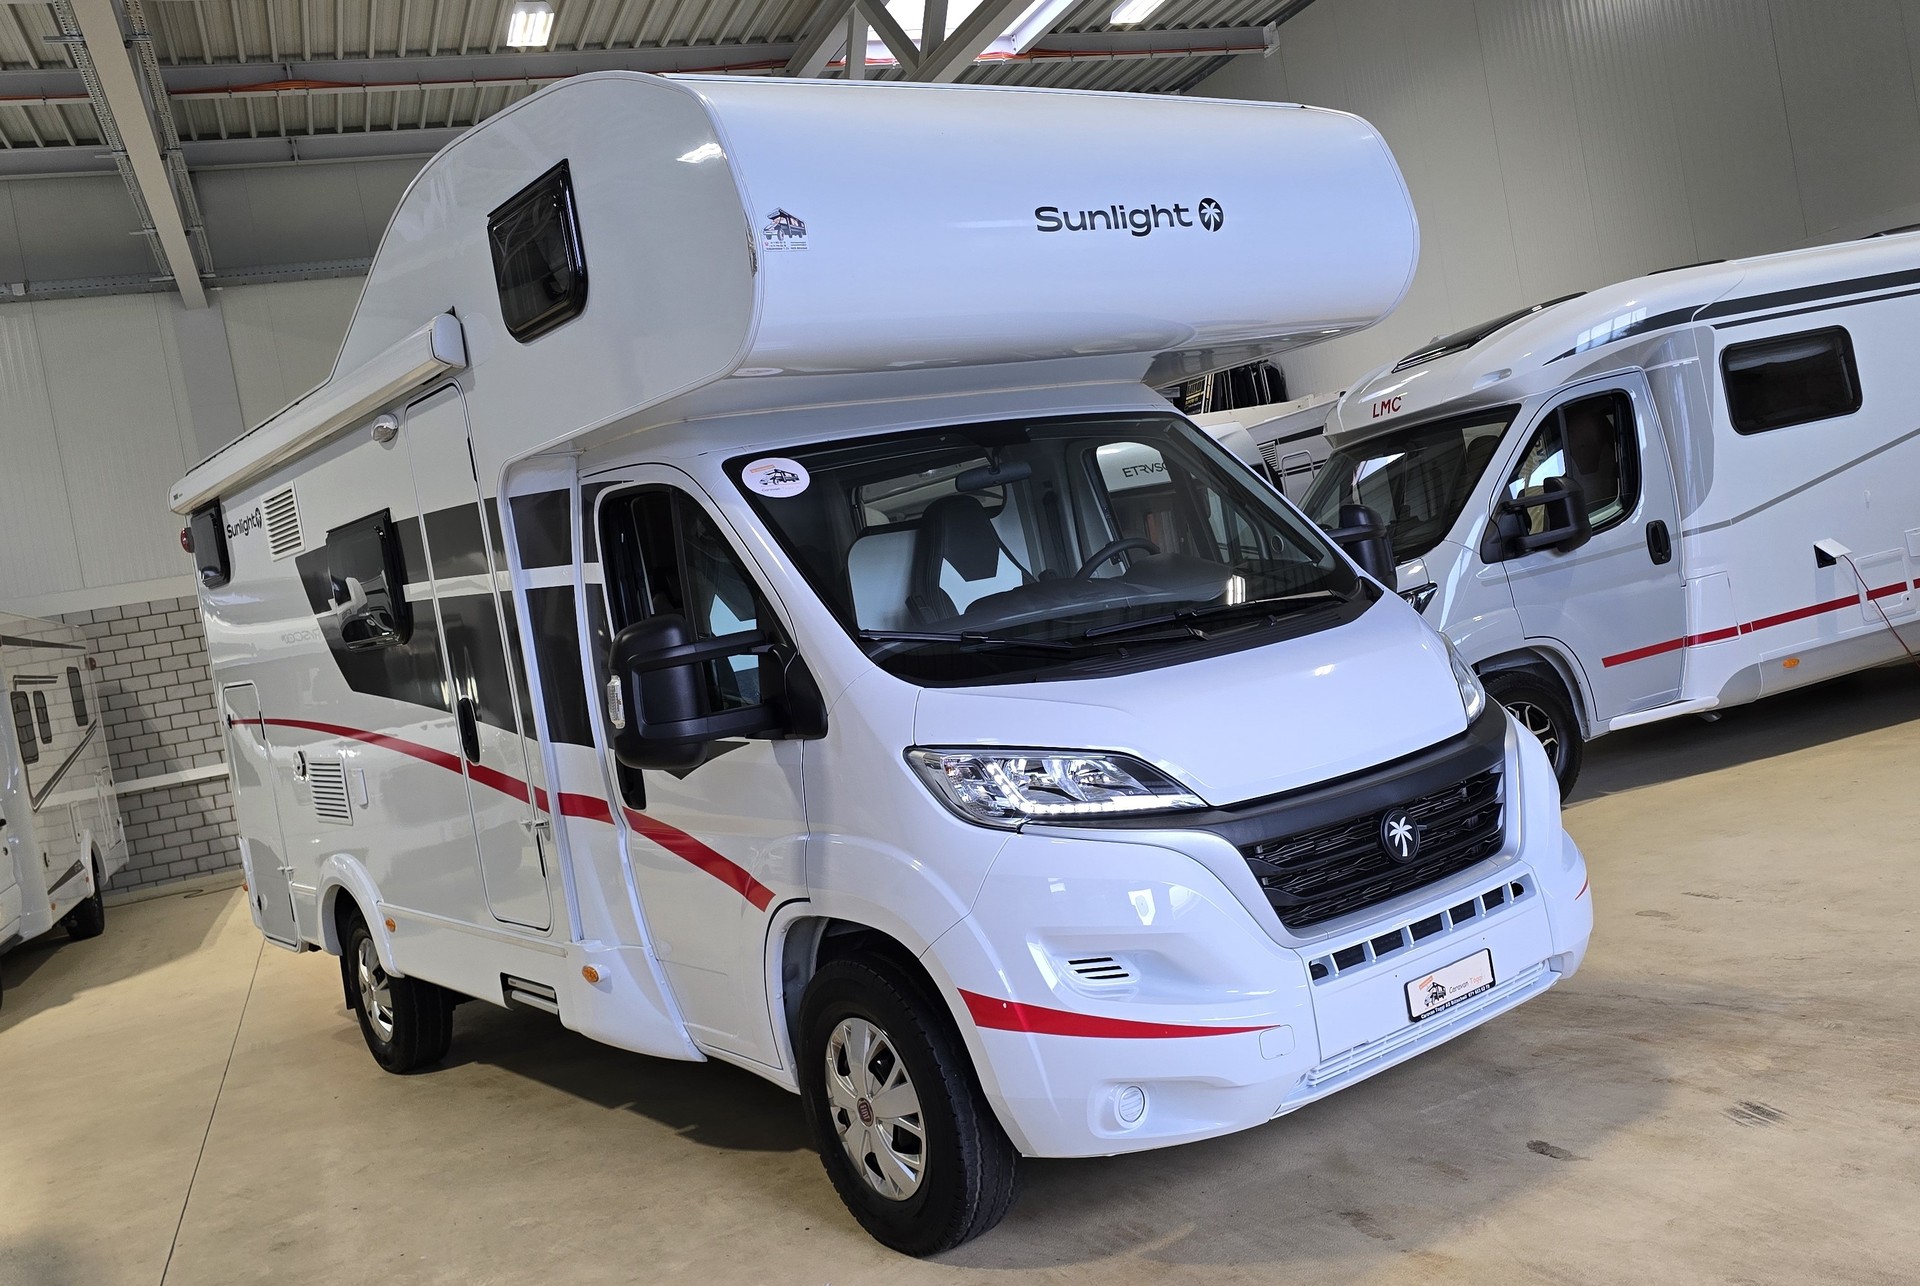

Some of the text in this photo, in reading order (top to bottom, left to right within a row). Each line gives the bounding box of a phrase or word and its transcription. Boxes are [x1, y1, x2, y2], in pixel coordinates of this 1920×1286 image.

[1034, 203, 1193, 237] Sunlight
[1372, 396, 1402, 418] LMC
[226, 513, 257, 539] Sunlight
[1448, 981, 1469, 994] Caravan
[860, 1104, 870, 1120] FIAT
